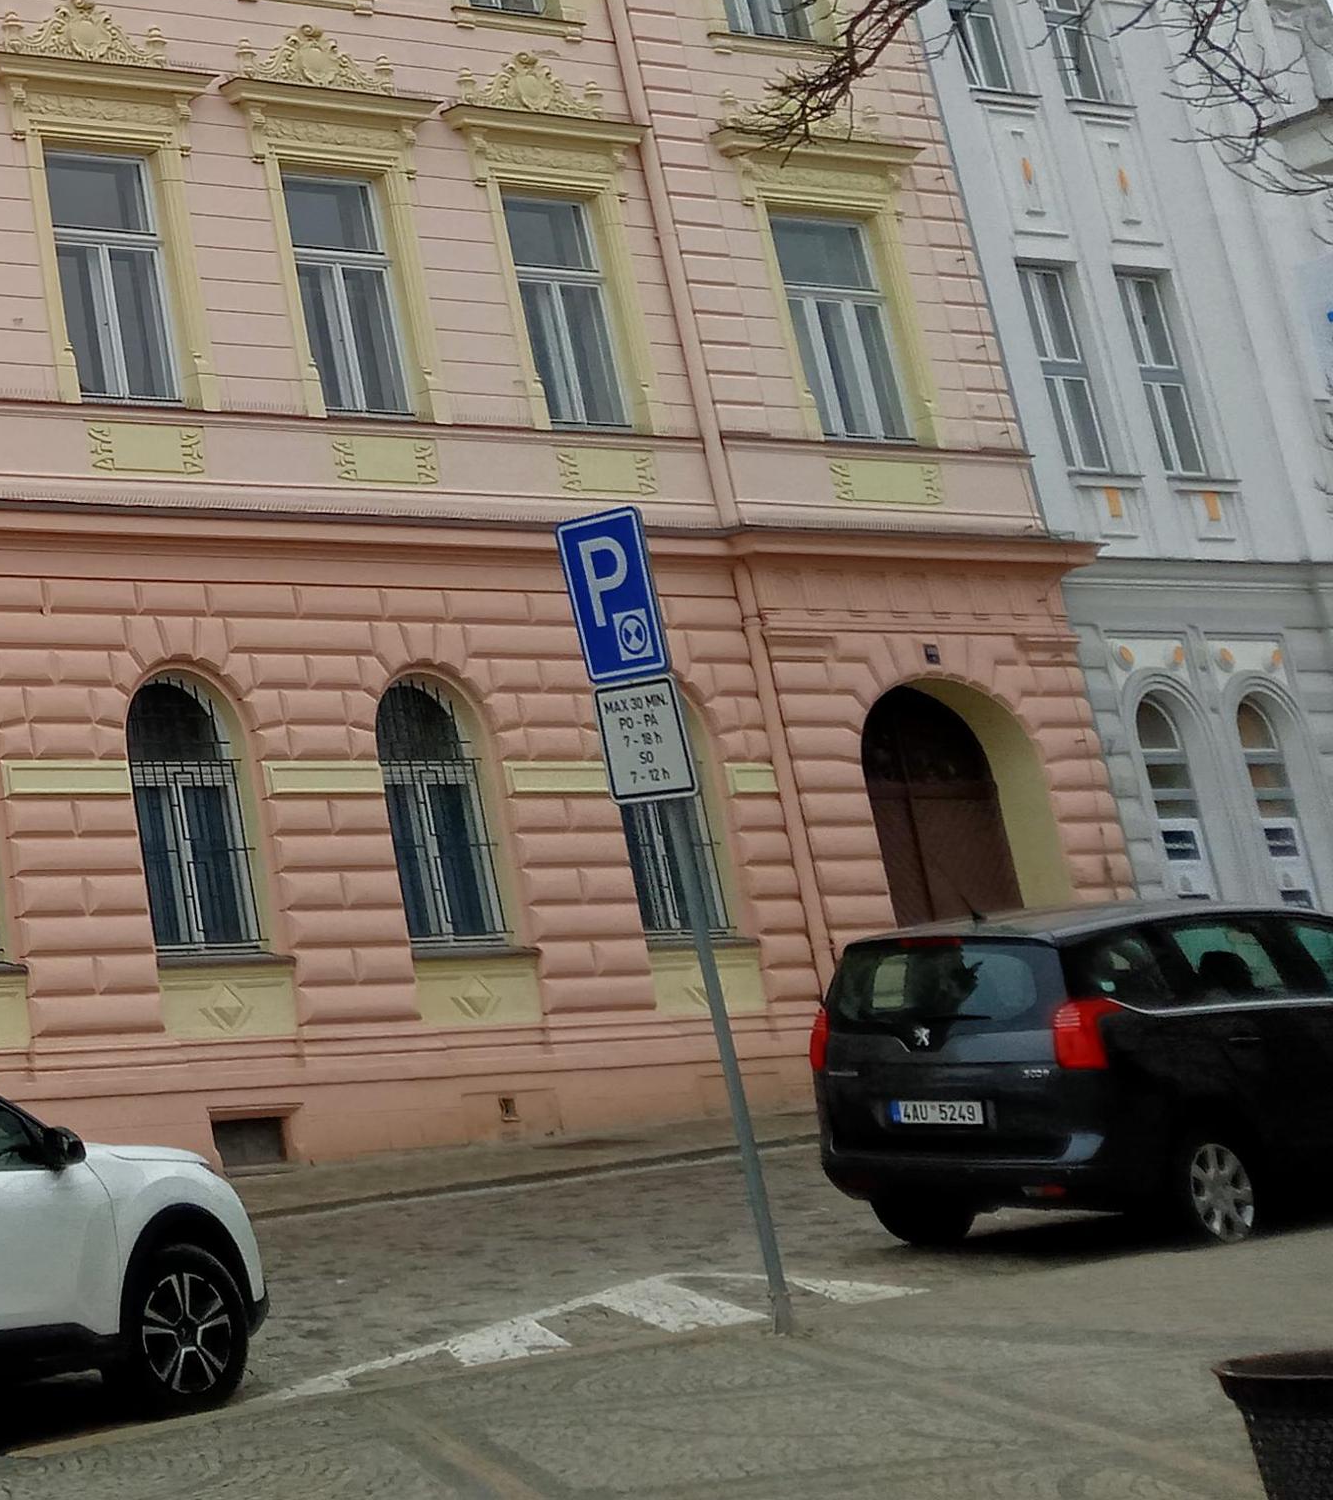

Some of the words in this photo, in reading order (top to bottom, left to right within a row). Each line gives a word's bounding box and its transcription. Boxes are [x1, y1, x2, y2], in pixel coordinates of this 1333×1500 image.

[578, 536, 628, 628] P
[604, 700, 629, 715] MAX
[630, 697, 644, 710] 30
[619, 716, 634, 730] PO
[623, 735, 630, 748] 7
[639, 751, 654, 765] SO
[630, 770, 637, 784] 7
[648, 769, 660, 782] 12
[903, 1104, 928, 1121] 4AU
[938, 1104, 976, 1122] 5249
